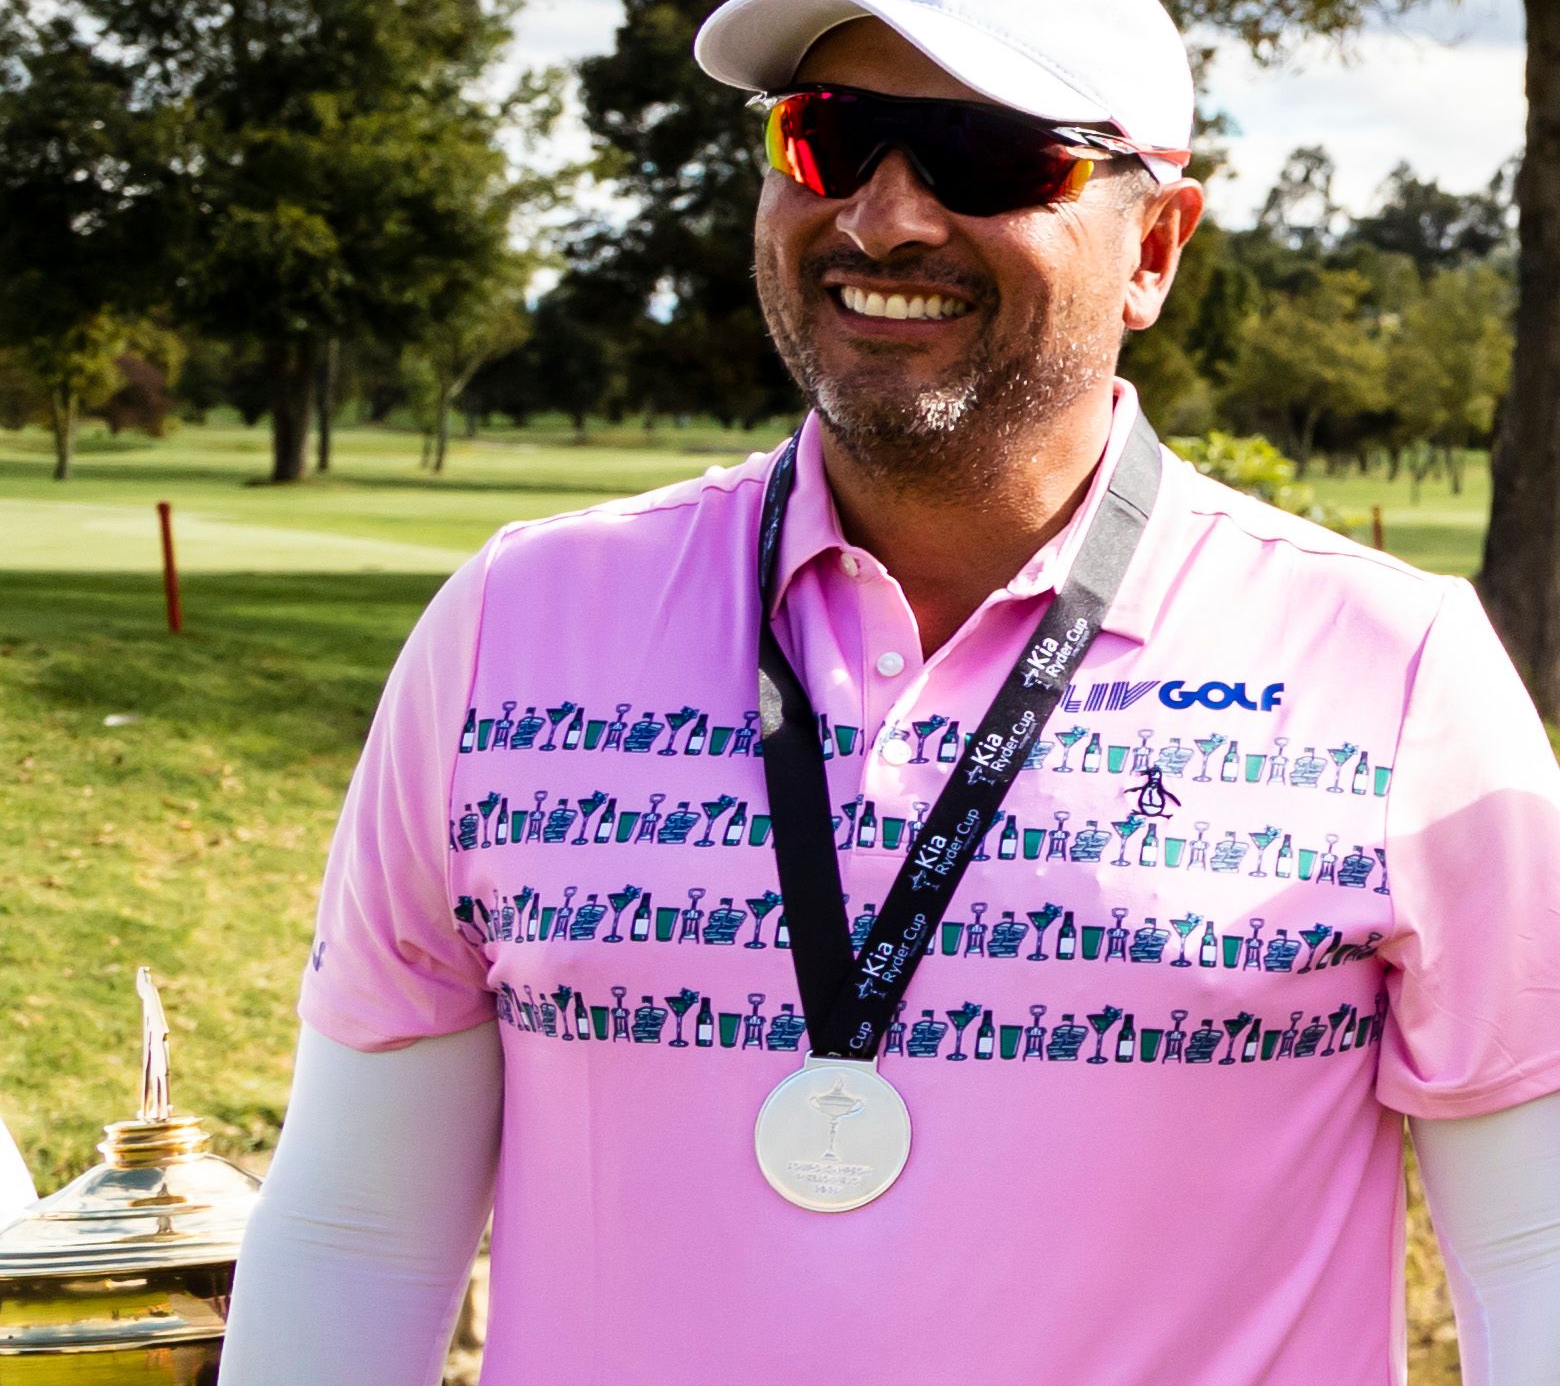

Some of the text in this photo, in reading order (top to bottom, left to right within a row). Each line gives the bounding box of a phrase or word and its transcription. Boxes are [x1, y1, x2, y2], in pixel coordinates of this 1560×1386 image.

[1067, 617, 1088, 644] Cup
[1027, 637, 1059, 671] Kia
[1159, 681, 1284, 711] GOLF
[1013, 711, 1035, 735] Cup
[971, 733, 1003, 766] Kia
[957, 809, 979, 835] Cup
[915, 835, 947, 869] Kia
[904, 914, 925, 940] Cup
[862, 943, 893, 977] Kia
[850, 1022, 871, 1049] Cup
